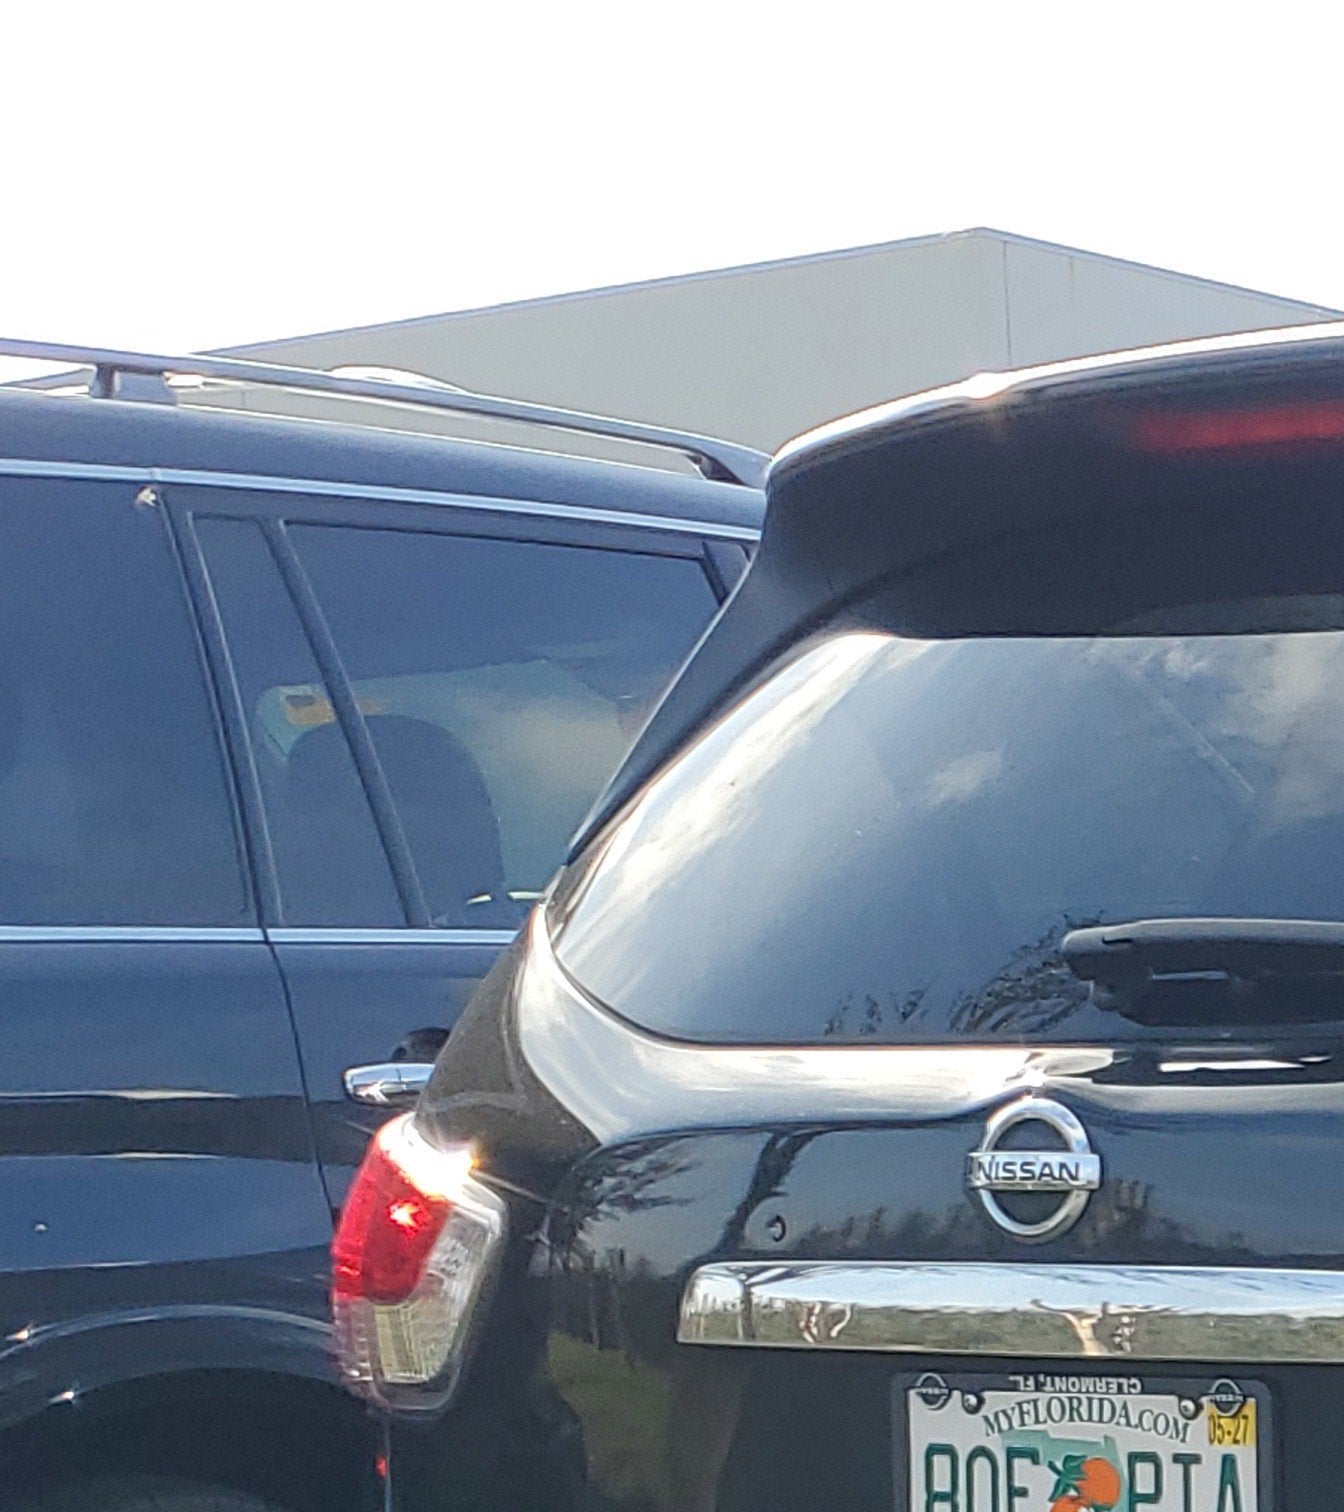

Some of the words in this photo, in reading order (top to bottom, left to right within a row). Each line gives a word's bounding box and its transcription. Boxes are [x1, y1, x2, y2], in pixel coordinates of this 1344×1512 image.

[977, 1161, 1080, 1182] NISSAN
[1039, 1374, 1142, 1394] CLERMONT,
[982, 1396, 1190, 1443] MYFLORIDA.COM
